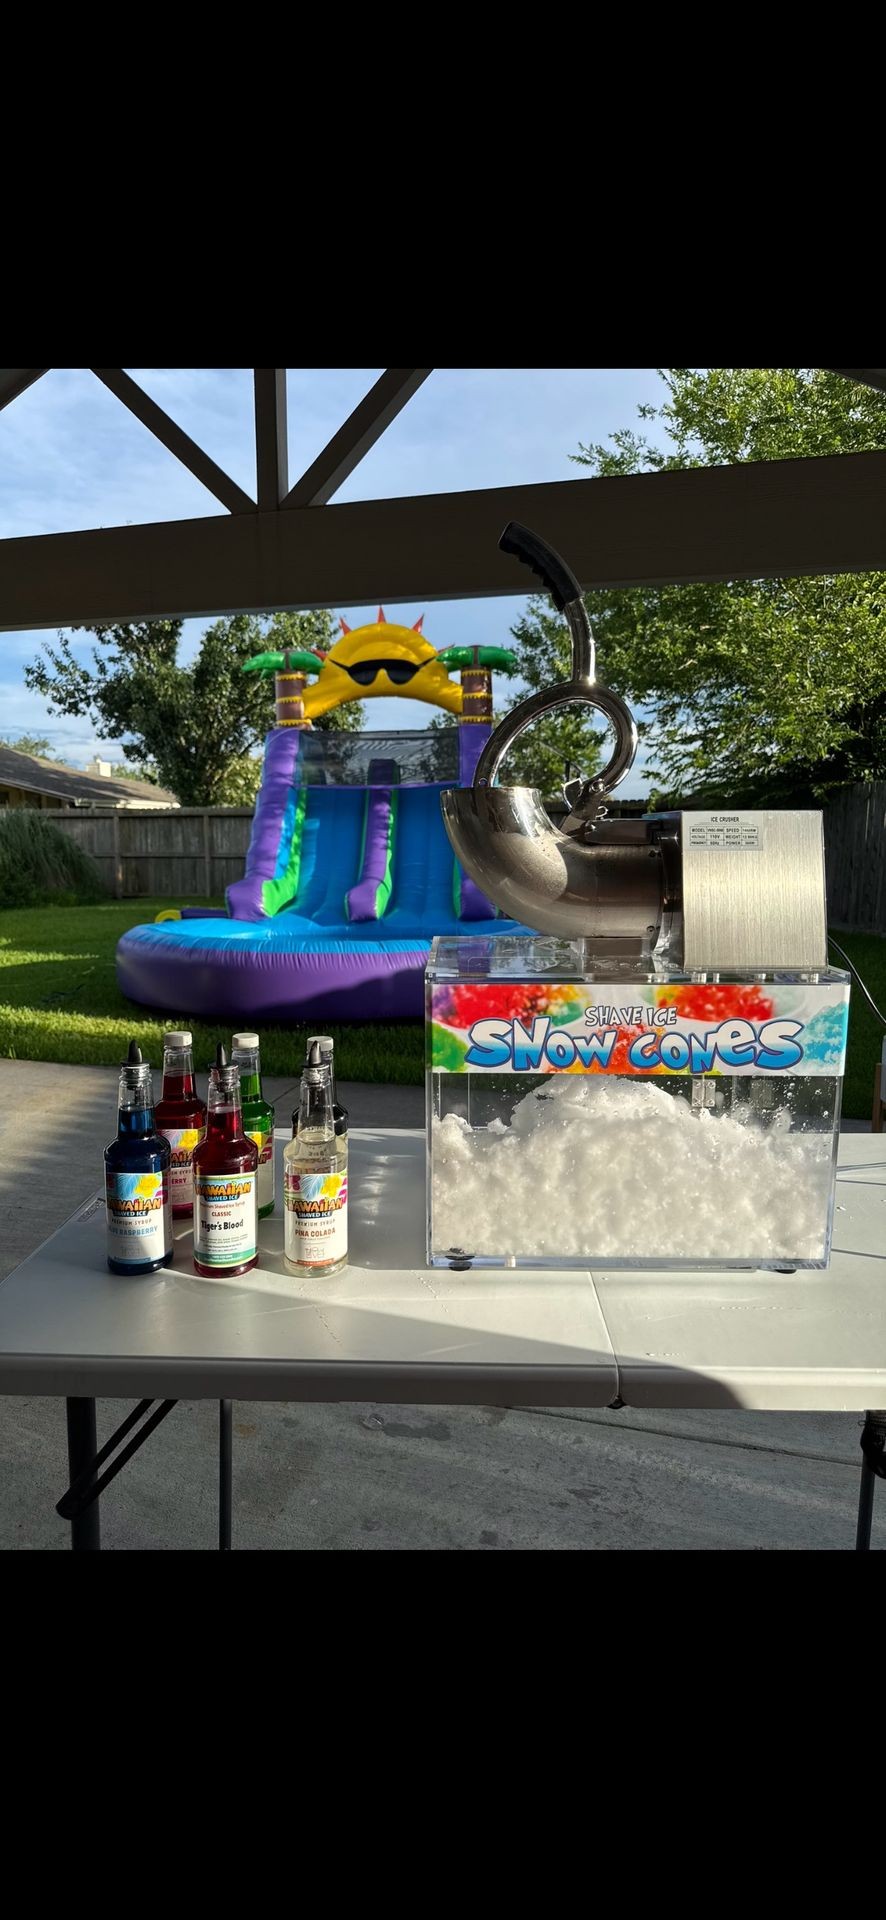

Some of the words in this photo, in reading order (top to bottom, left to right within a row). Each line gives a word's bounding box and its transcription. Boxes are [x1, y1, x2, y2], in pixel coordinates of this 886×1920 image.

[585, 1006, 643, 1027] SHAVE
[647, 1006, 678, 1026] ICE
[464, 1016, 621, 1072] SNOW
[171, 1177, 187, 1185] ERRY
[195, 1181, 252, 1196] HAWAIIAN
[287, 1197, 344, 1212] HAWAIIAN
[134, 1218, 152, 1226] SYRUP
[201, 1220, 222, 1232] Tiger's
[223, 1218, 244, 1230] Blood
[320, 1218, 336, 1226] SYRUP
[119, 1225, 158, 1236] RASPBERRY
[310, 1226, 336, 1238] COLADA
